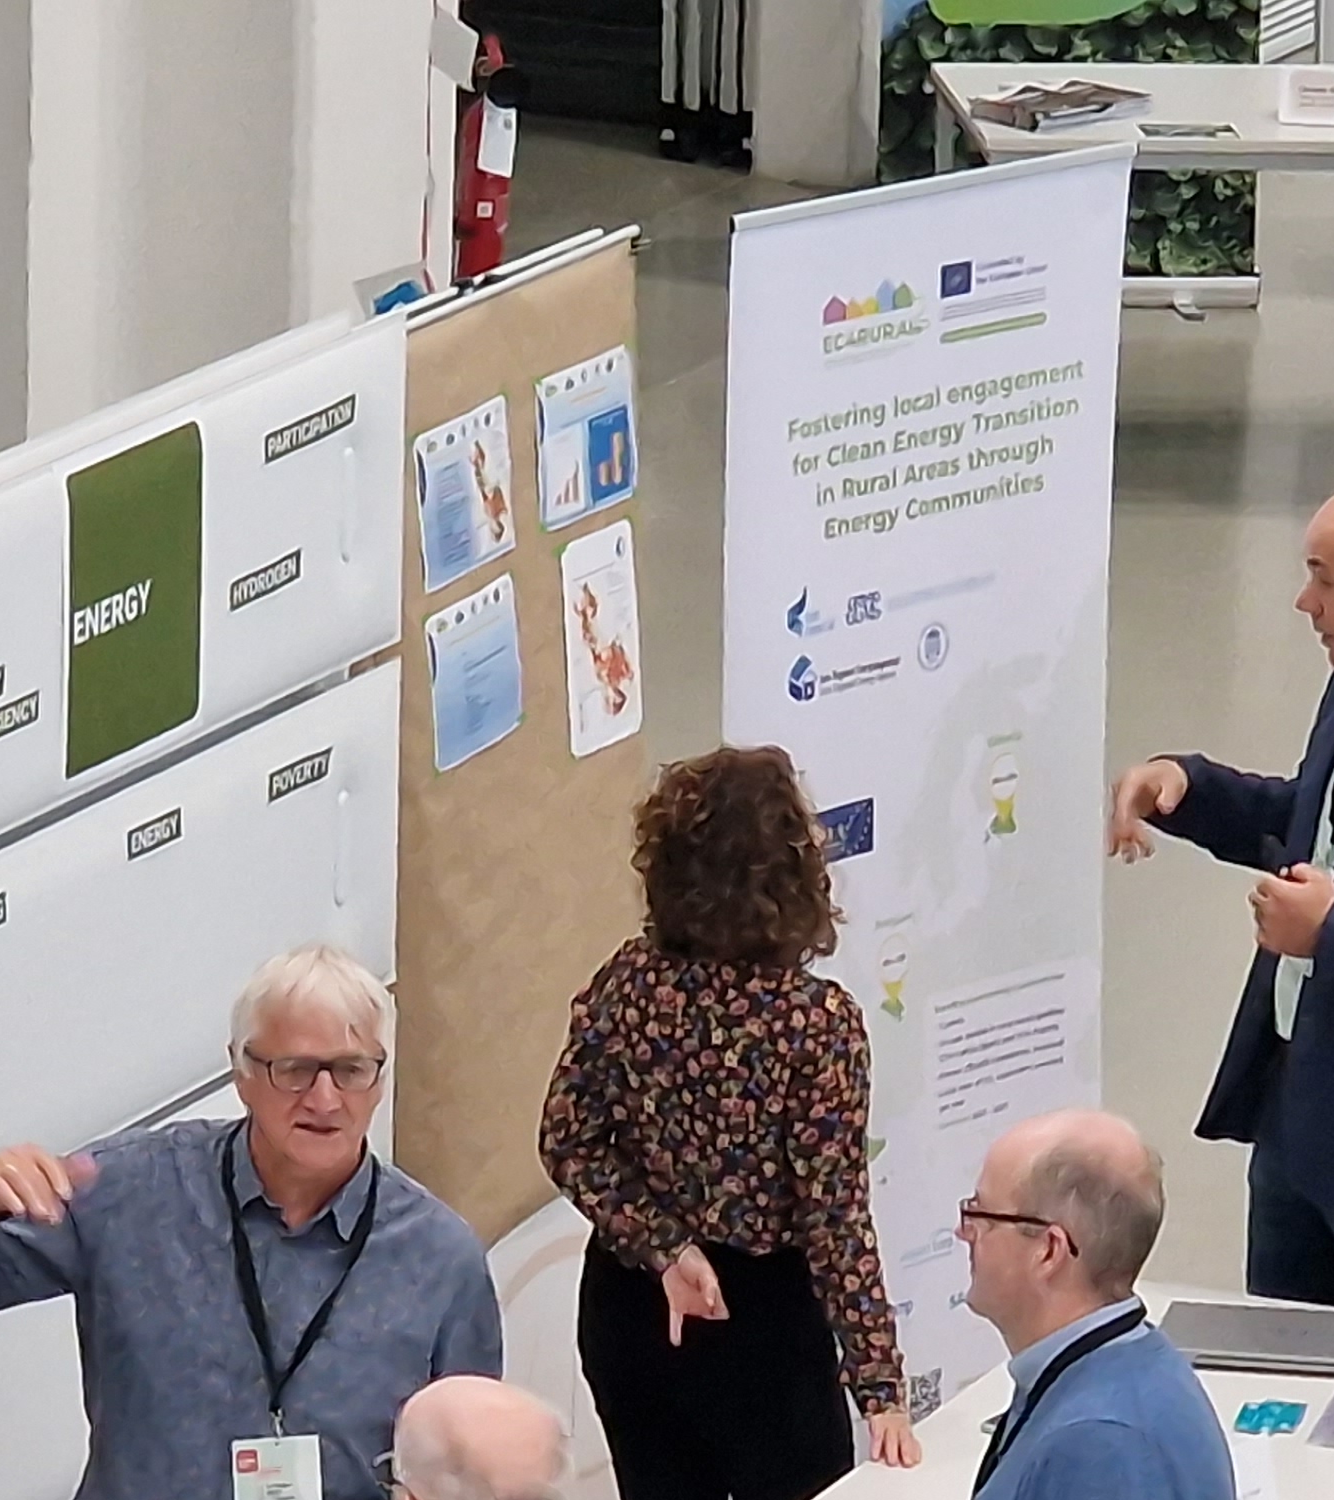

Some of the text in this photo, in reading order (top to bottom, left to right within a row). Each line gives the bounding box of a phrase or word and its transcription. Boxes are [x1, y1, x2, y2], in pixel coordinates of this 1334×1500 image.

[267, 400, 353, 457] PARTICIPATION
[788, 360, 1083, 441] Fostering local engagement
[793, 397, 1079, 475] for Clean Energy Transition
[817, 435, 1054, 506] in Rural Areas through
[825, 473, 1045, 540] Energy Communities
[233, 555, 297, 604] HYDROGEN
[73, 580, 152, 646] ENERGY
[272, 755, 328, 797] POVERTY
[131, 815, 179, 852] ENERGY
